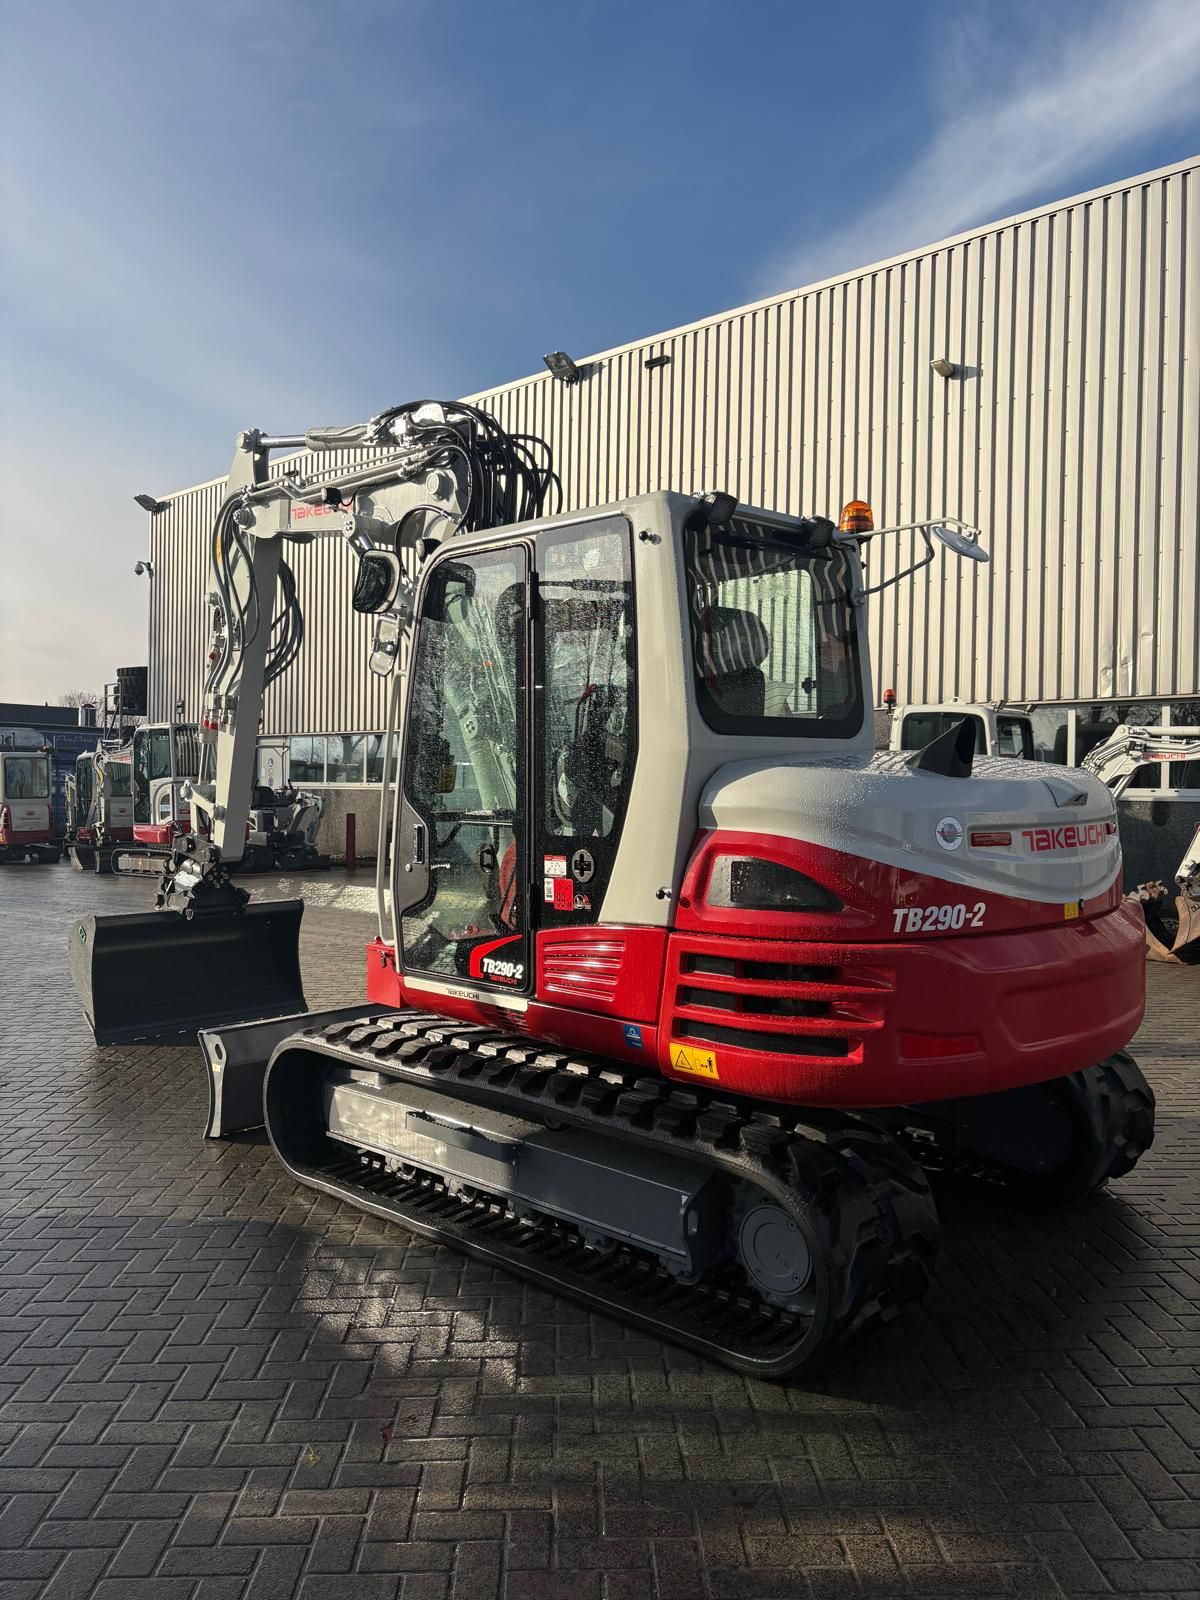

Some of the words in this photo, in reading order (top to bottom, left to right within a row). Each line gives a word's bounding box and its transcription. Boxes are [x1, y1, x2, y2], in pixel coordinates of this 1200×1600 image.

[893, 902, 986, 933] TB290-2
[483, 958, 523, 979] TB290-2
[446, 988, 480, 1000] TAKEUCHI
